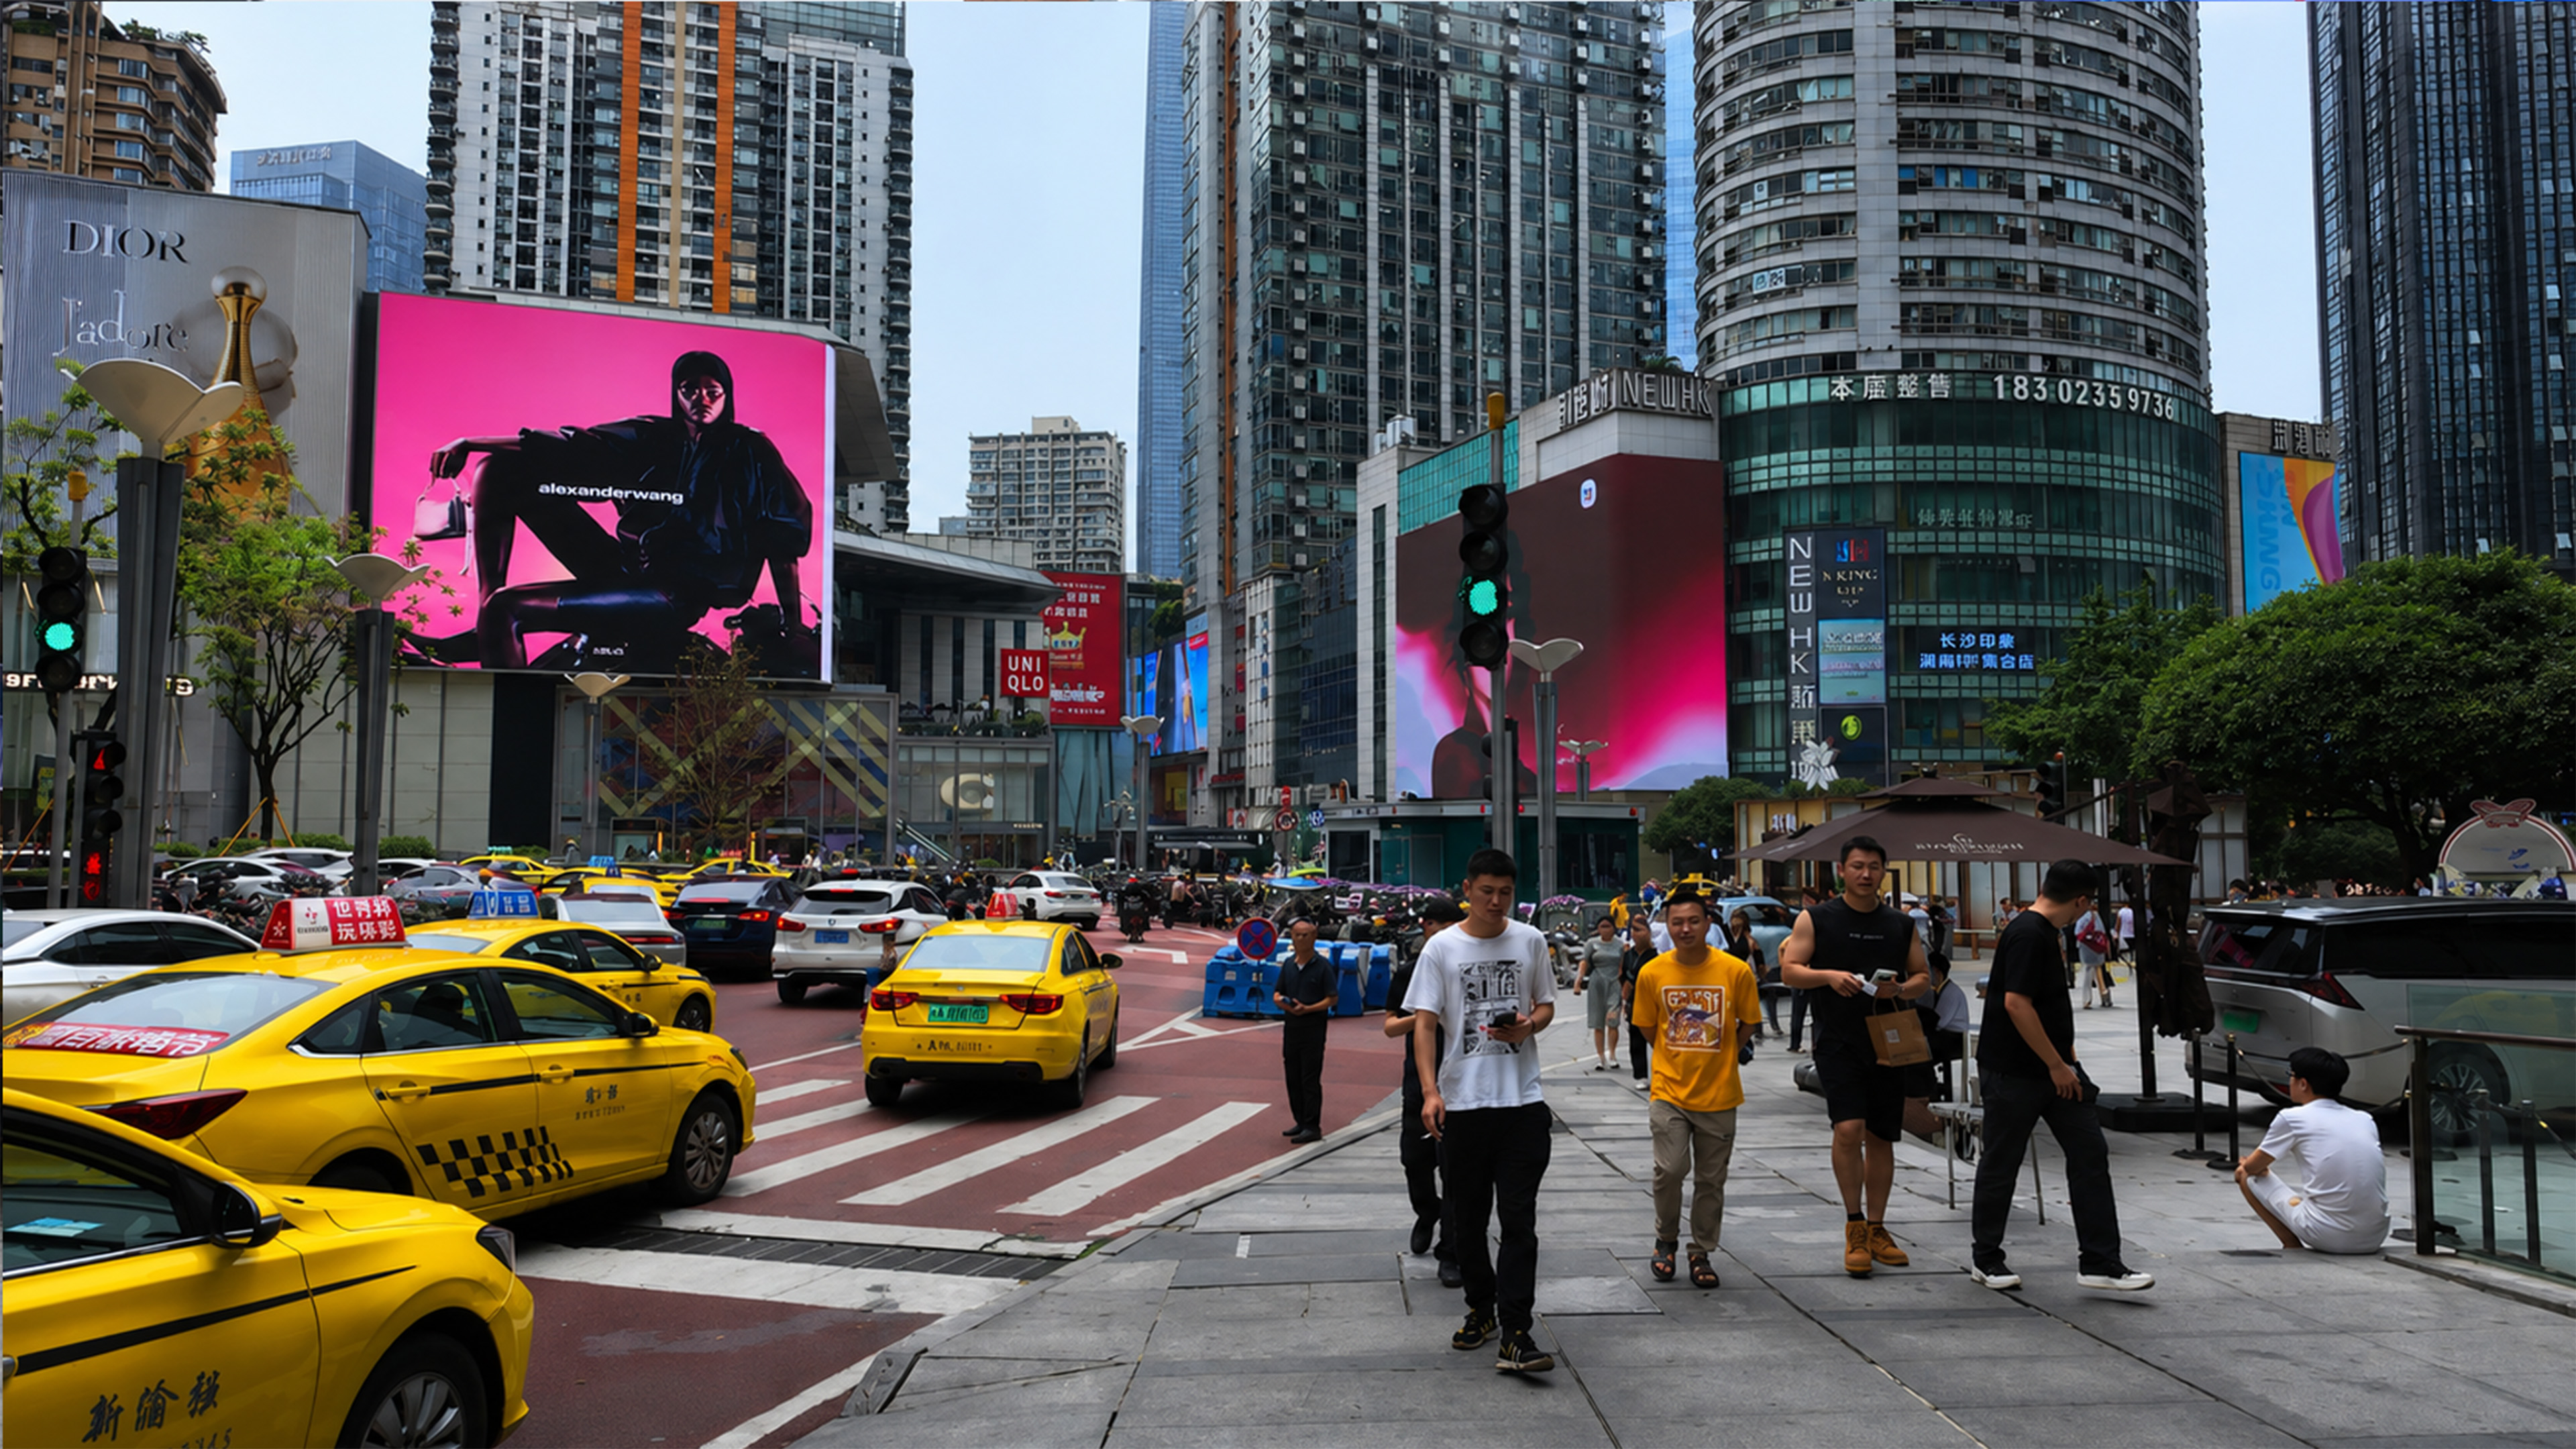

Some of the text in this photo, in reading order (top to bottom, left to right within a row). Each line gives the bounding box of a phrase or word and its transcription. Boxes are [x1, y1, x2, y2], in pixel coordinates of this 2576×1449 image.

[62, 219, 191, 265] DIOR
[538, 482, 684, 505] alexanderwang
[1008, 655, 1040, 672] UNI
[1008, 674, 1044, 693] QLO
